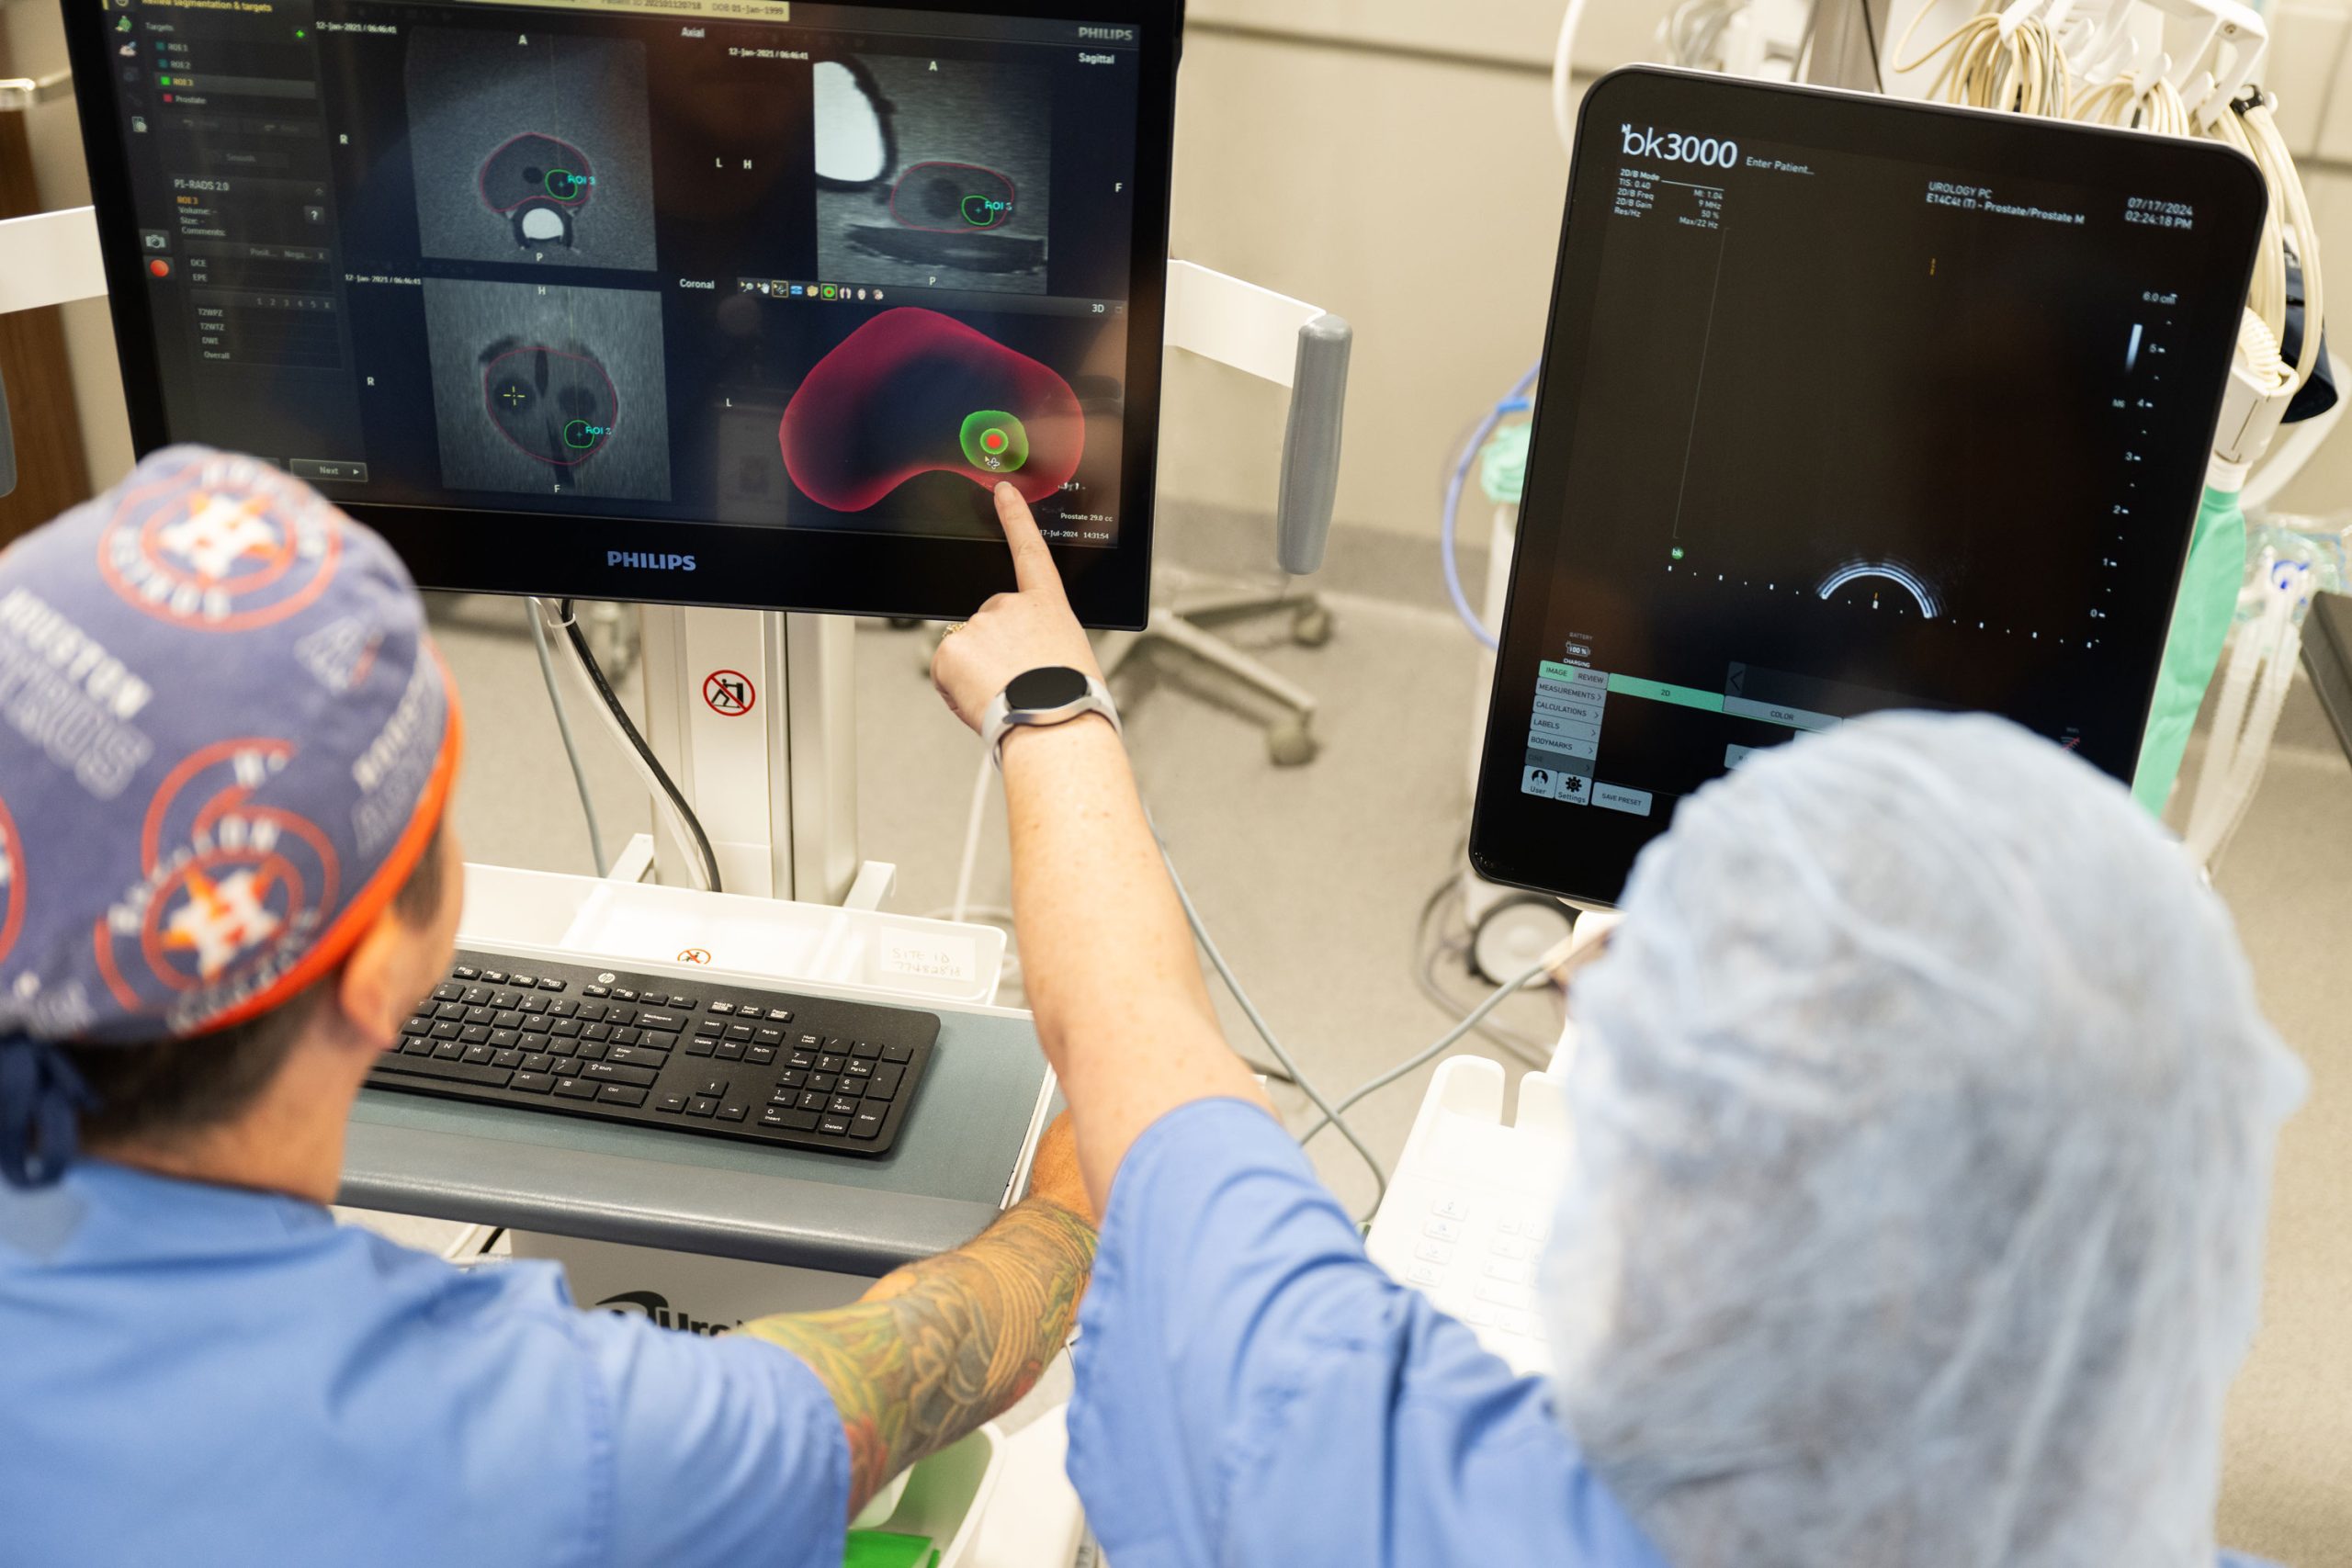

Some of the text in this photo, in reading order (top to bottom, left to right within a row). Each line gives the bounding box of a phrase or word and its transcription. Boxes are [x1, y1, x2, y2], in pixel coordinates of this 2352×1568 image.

[243, 3, 273, 13] targets
[145, 22, 175, 33] Targets
[681, 27, 706, 39] Axial
[518, 34, 526, 45] A
[1079, 27, 1134, 41] PHILIPS
[1079, 52, 1114, 65] Sagittal
[929, 61, 938, 71] A
[175, 95, 207, 105] Prostate
[340, 135, 348, 144] R
[1623, 127, 1738, 168] bk3000
[717, 158, 723, 167] L
[744, 160, 752, 169] H
[1746, 155, 1771, 169] Enter
[567, 174, 586, 185] ROI
[1620, 169, 1660, 183] 2D/B Mode
[1115, 183, 1123, 192] F
[1618, 178, 1651, 190] TIS: 0.40
[1617, 187, 1655, 201] 2D/B Freq
[1707, 191, 1724, 201] 1.04
[1928, 182, 1992, 199] UROLOGY PC
[985, 200, 1004, 210] ROI
[1615, 197, 1652, 210] 2D/B Gain
[1699, 199, 1722, 211] 9 MHz
[2127, 197, 2193, 217] 07/17/2024
[1614, 207, 1641, 219] Res/Hz
[1702, 209, 1712, 219] 50
[1984, 203, 2073, 223] Prostate/Prostate
[2074, 215, 2085, 225] M
[1679, 215, 1720, 231] Max/22 Hz
[2124, 209, 2193, 230] 02:24:18 PM
[536, 253, 544, 263] P
[680, 278, 715, 289] Coronal
[930, 276, 936, 286] P
[538, 287, 547, 296] H
[1091, 304, 1105, 315] 3D
[2149, 344, 2156, 353] 5
[204, 351, 230, 360] Overall
[368, 378, 375, 387] R
[727, 399, 733, 408] L
[2137, 399, 2144, 408] 4
[585, 425, 603, 436] ROI
[2126, 452, 2132, 461] 3
[320, 466, 339, 476] Next
[553, 483, 560, 493] F
[2113, 505, 2120, 514] 2
[1060, 512, 1089, 521] Prostate
[1090, 514, 1103, 523] 29.0
[606, 550, 697, 572] PHILIPS
[2103, 558, 2109, 567] 1
[2090, 608, 2098, 618] 0
[1569, 632, 1593, 641] BATTERY
[1569, 646, 1589, 656] 100 %
[1564, 658, 1590, 669] CHARGING
[1545, 667, 1604, 684] IMAGE REVIEW
[1539, 683, 1596, 701] MEASUREMENTS
[1660, 688, 1670, 698] 2D
[1536, 701, 1588, 717] CALCULATIONS
[1770, 710, 1794, 721] COLOR
[1533, 717, 1560, 731] LABELS
[1531, 735, 1573, 751] BODYMARKS
[1530, 785, 1586, 805] User Settings
[1601, 793, 1643, 807] SAVE PRESET
[891, 947, 951, 964] SITE ID
[598, 972, 616, 984] hp
[644, 1013, 672, 1022] Backspace
